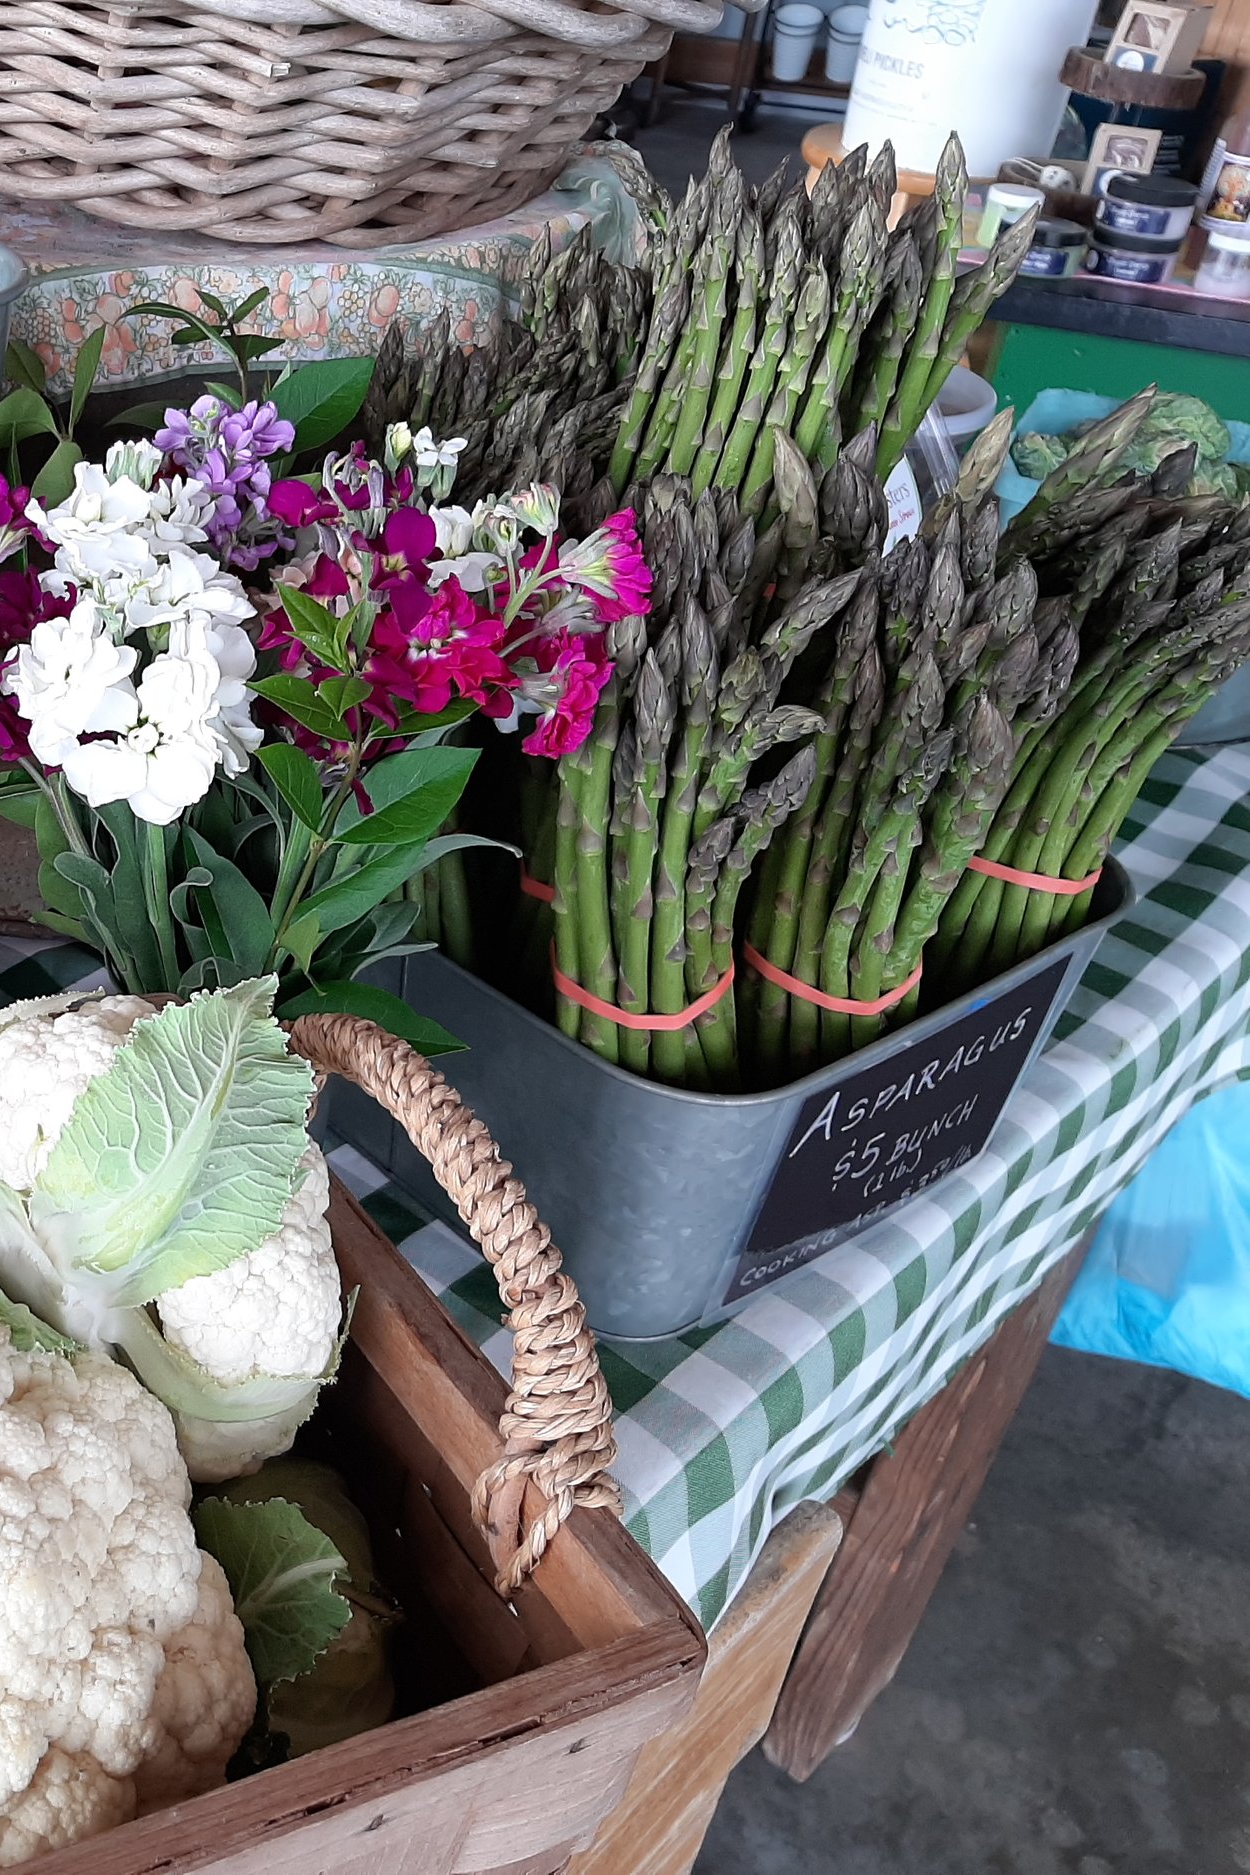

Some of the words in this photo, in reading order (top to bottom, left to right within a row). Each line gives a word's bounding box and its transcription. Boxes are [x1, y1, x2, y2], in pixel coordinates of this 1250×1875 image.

[874, 51, 925, 79] PICKLES
[788, 1006, 1033, 1159] ASPARAGUS
[831, 1132, 886, 1192] $5
[885, 1093, 979, 1167] BUNCH
[739, 1228, 838, 1287] COOKING
